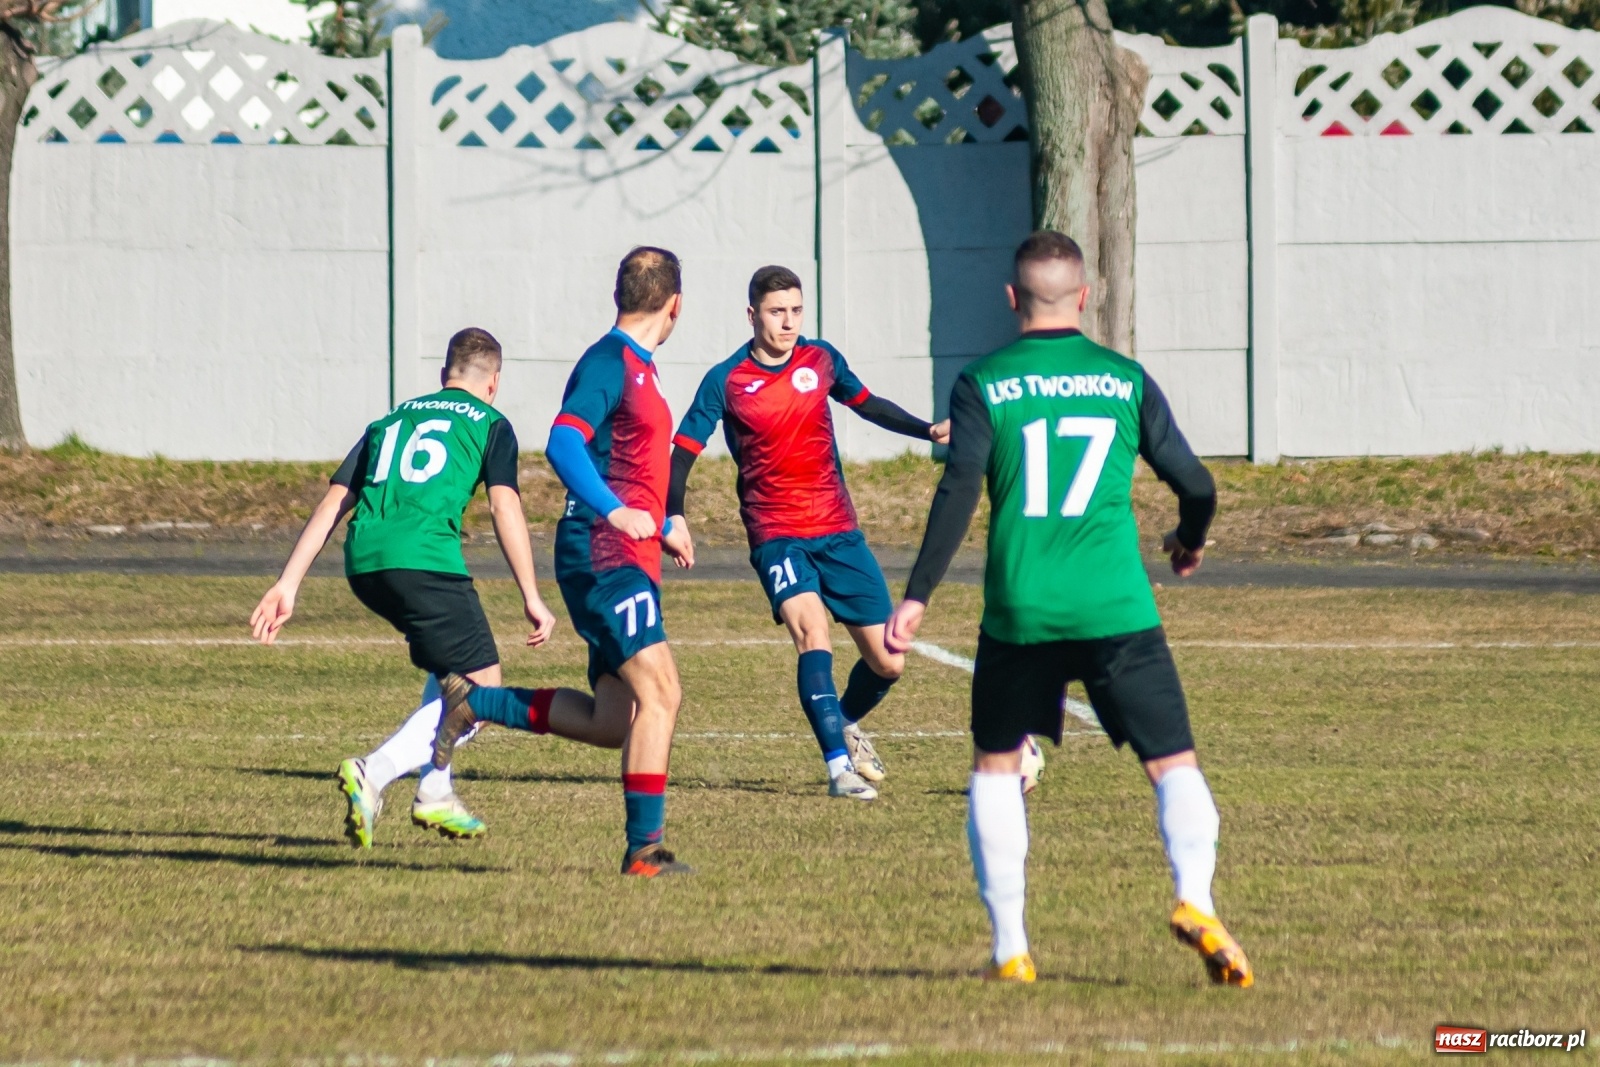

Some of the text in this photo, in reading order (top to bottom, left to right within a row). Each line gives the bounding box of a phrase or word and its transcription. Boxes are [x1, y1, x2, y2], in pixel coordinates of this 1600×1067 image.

[986, 372, 1133, 405] LKS TWORKÓW
[403, 400, 486, 422] TWORKÓW
[373, 419, 451, 483] 16
[1022, 416, 1117, 517] 17
[768, 556, 799, 597] 21
[614, 591, 656, 637] 77
